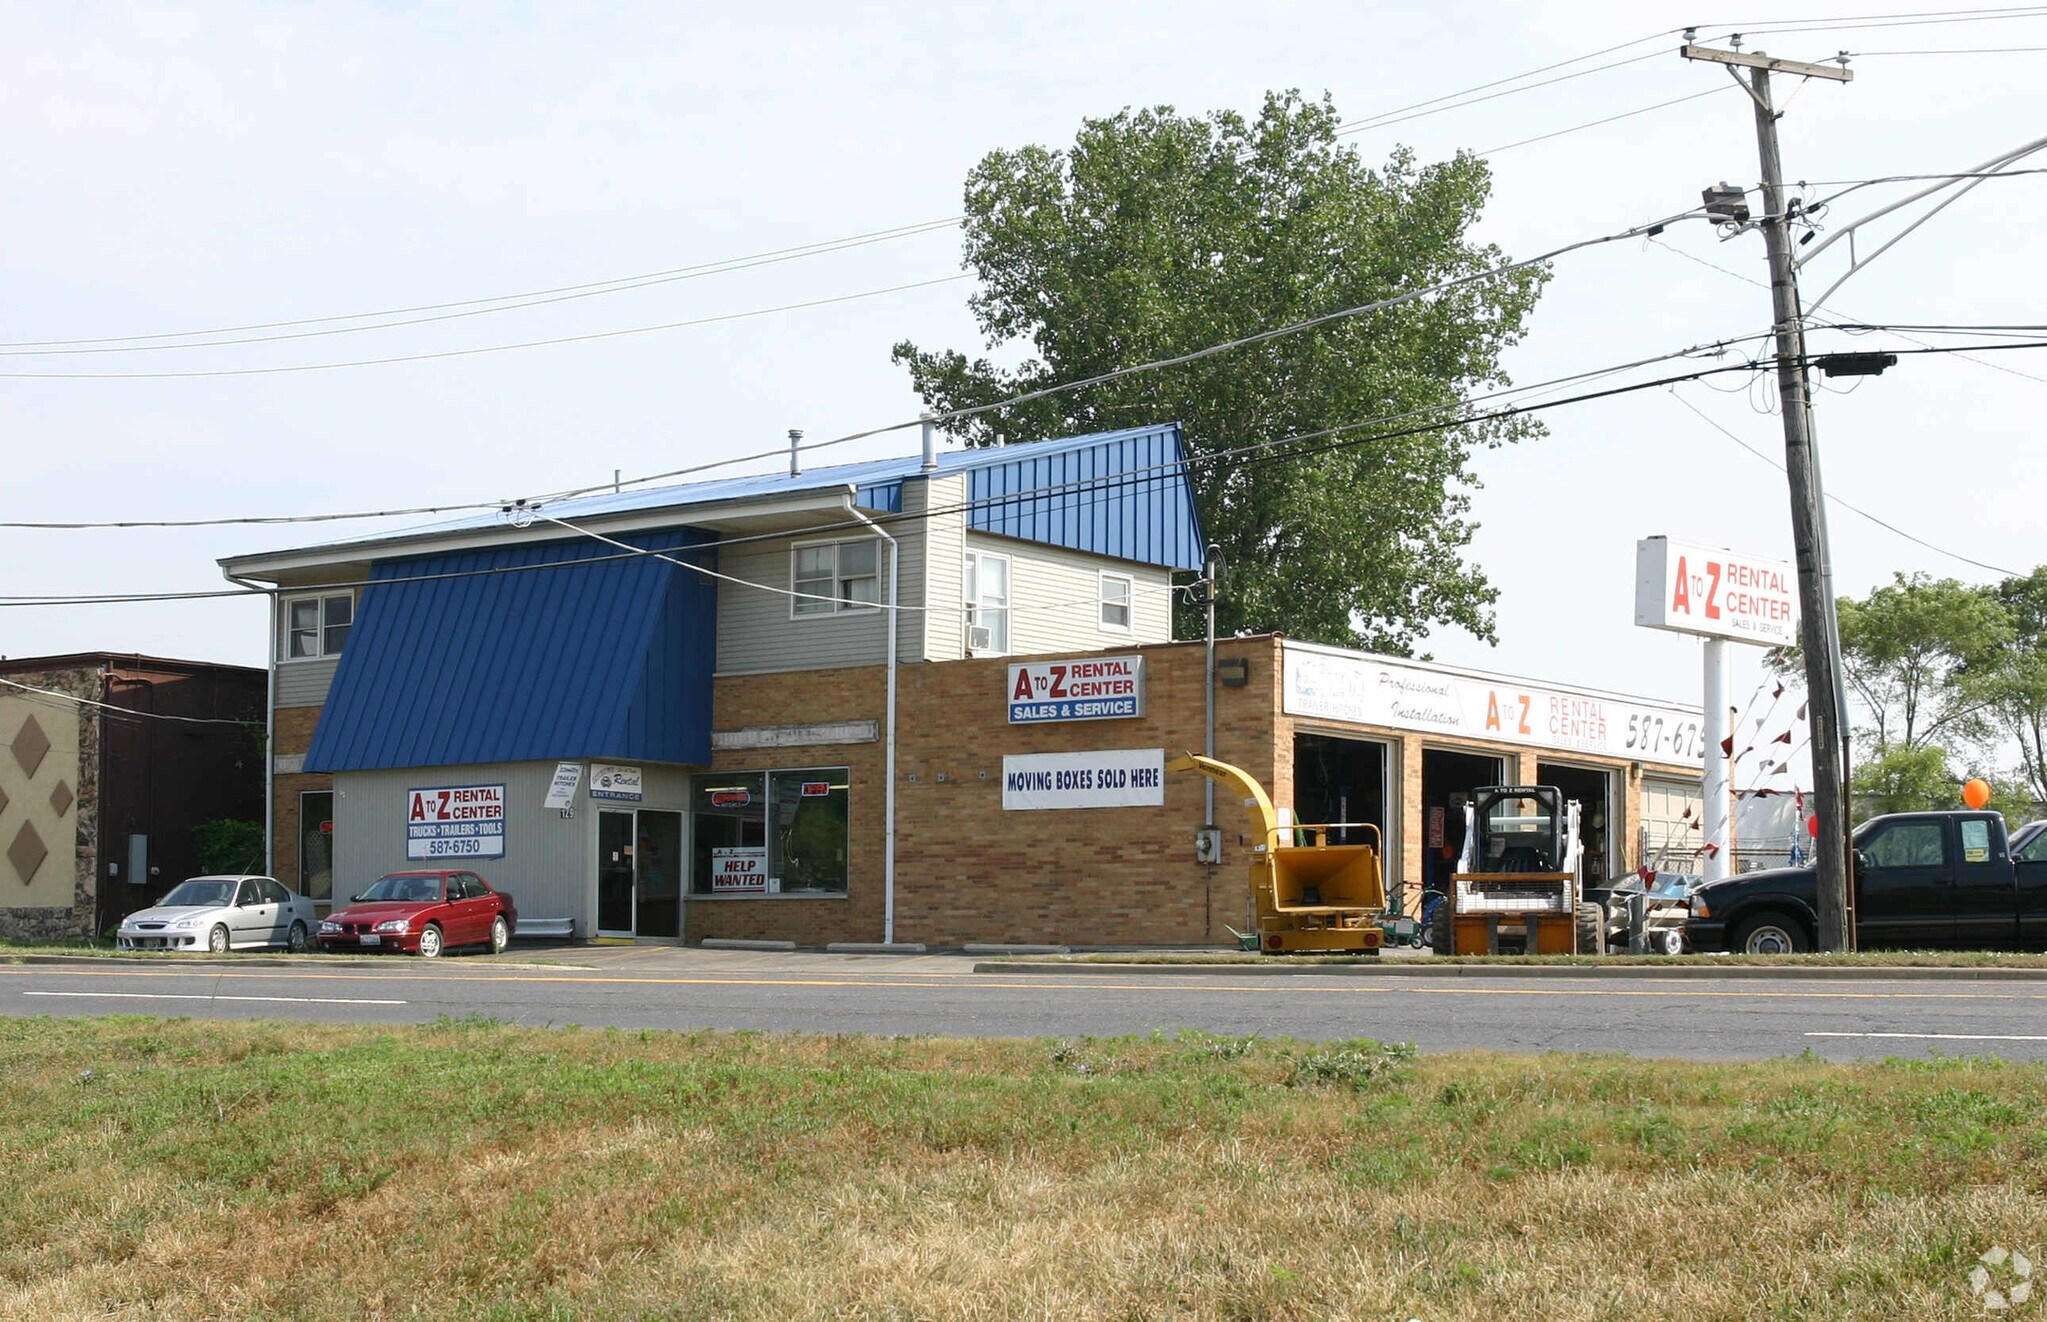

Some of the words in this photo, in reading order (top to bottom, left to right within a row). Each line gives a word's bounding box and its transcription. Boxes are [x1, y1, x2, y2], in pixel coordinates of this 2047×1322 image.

[1672, 556, 1690, 615] A
[1691, 575, 1704, 597] TO
[1705, 561, 1721, 620] Z
[1727, 563, 1789, 594] RENTAL
[1726, 592, 1790, 621] CENTER
[1731, 617, 1750, 630] SALES
[1759, 623, 1783, 636] SERVICE
[1071, 661, 1132, 678] RENTAL
[1013, 668, 1034, 700] A
[1034, 676, 1048, 691] TO
[1049, 666, 1067, 698] Z
[1069, 679, 1134, 697] CENTER
[1378, 671, 1449, 697] Professional
[1014, 705, 1057, 719] SALES
[1061, 704, 1071, 717] &
[1074, 700, 1133, 716] SERVICE
[1390, 700, 1459, 726] Installation
[1485, 690, 1501, 731] A
[1502, 703, 1515, 721] TO
[1518, 694, 1531, 734] Z
[1550, 696, 1606, 722] RENTAL
[1549, 715, 1607, 741] CENTER
[1007, 771, 1052, 791] MOVING
[1056, 769, 1093, 790] BOXES
[1097, 768, 1126, 789] SOLD
[1131, 767, 1159, 788] HERE
[410, 792, 425, 820] A
[426, 800, 436, 812] TO
[437, 791, 450, 820] Z
[454, 789, 500, 802] RENTAL
[592, 790, 640, 800] ENTRANCE
[453, 805, 502, 819] CENTER
[409, 826, 436, 837] TRUCKS
[441, 824, 475, 836] TRAILERS
[479, 822, 503, 834] TOOLS
[430, 840, 480, 854] 587-6750
[724, 861, 756, 872] HELP
[714, 874, 765, 886] WANTED
